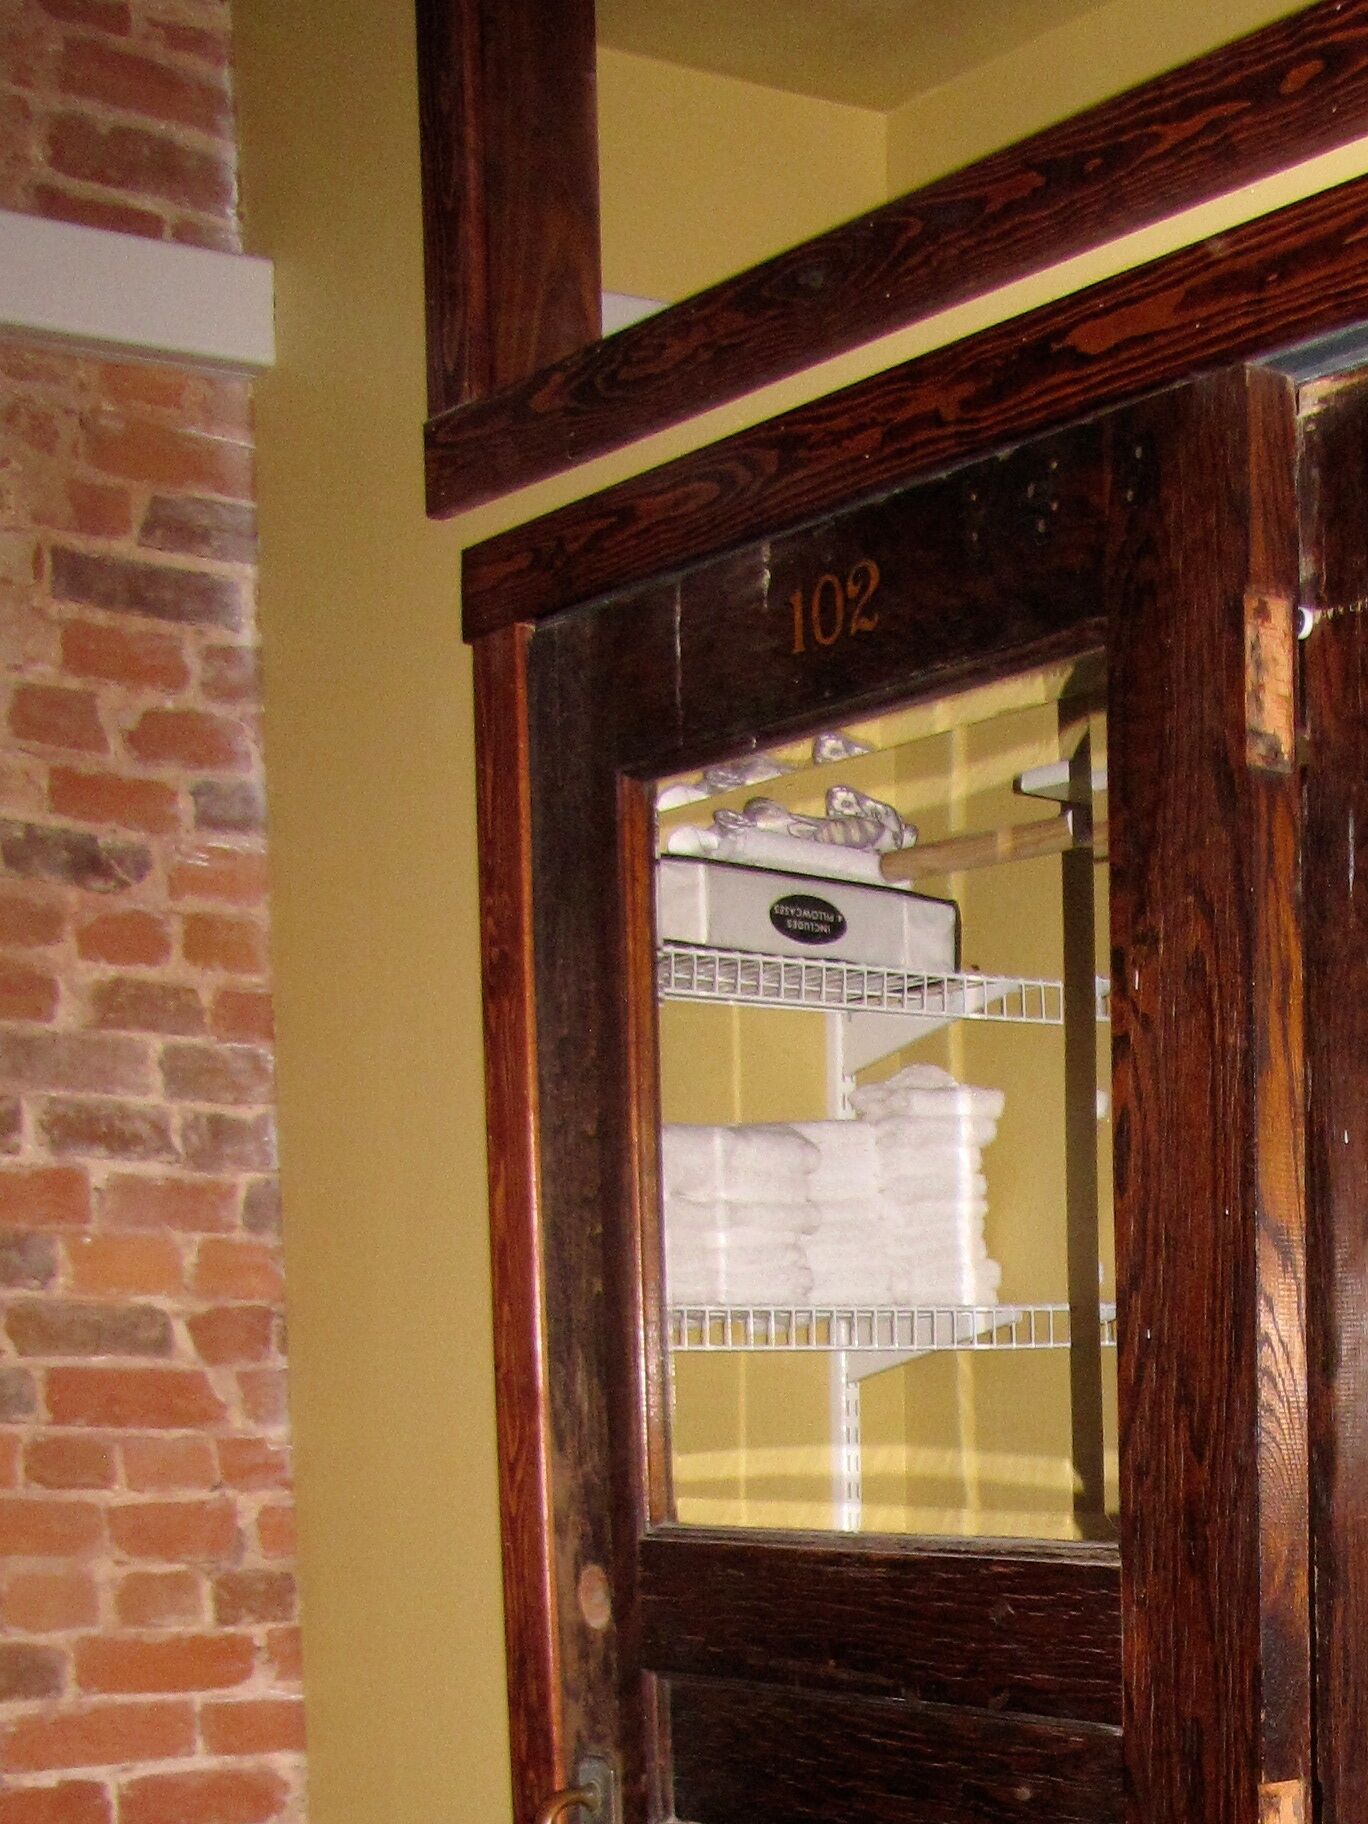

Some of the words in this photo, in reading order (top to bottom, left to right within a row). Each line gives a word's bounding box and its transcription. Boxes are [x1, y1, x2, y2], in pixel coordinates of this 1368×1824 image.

[789, 559, 879, 654] 102
[773, 904, 835, 923] PILLOWCASES
[786, 920, 831, 935] INCLUDES
